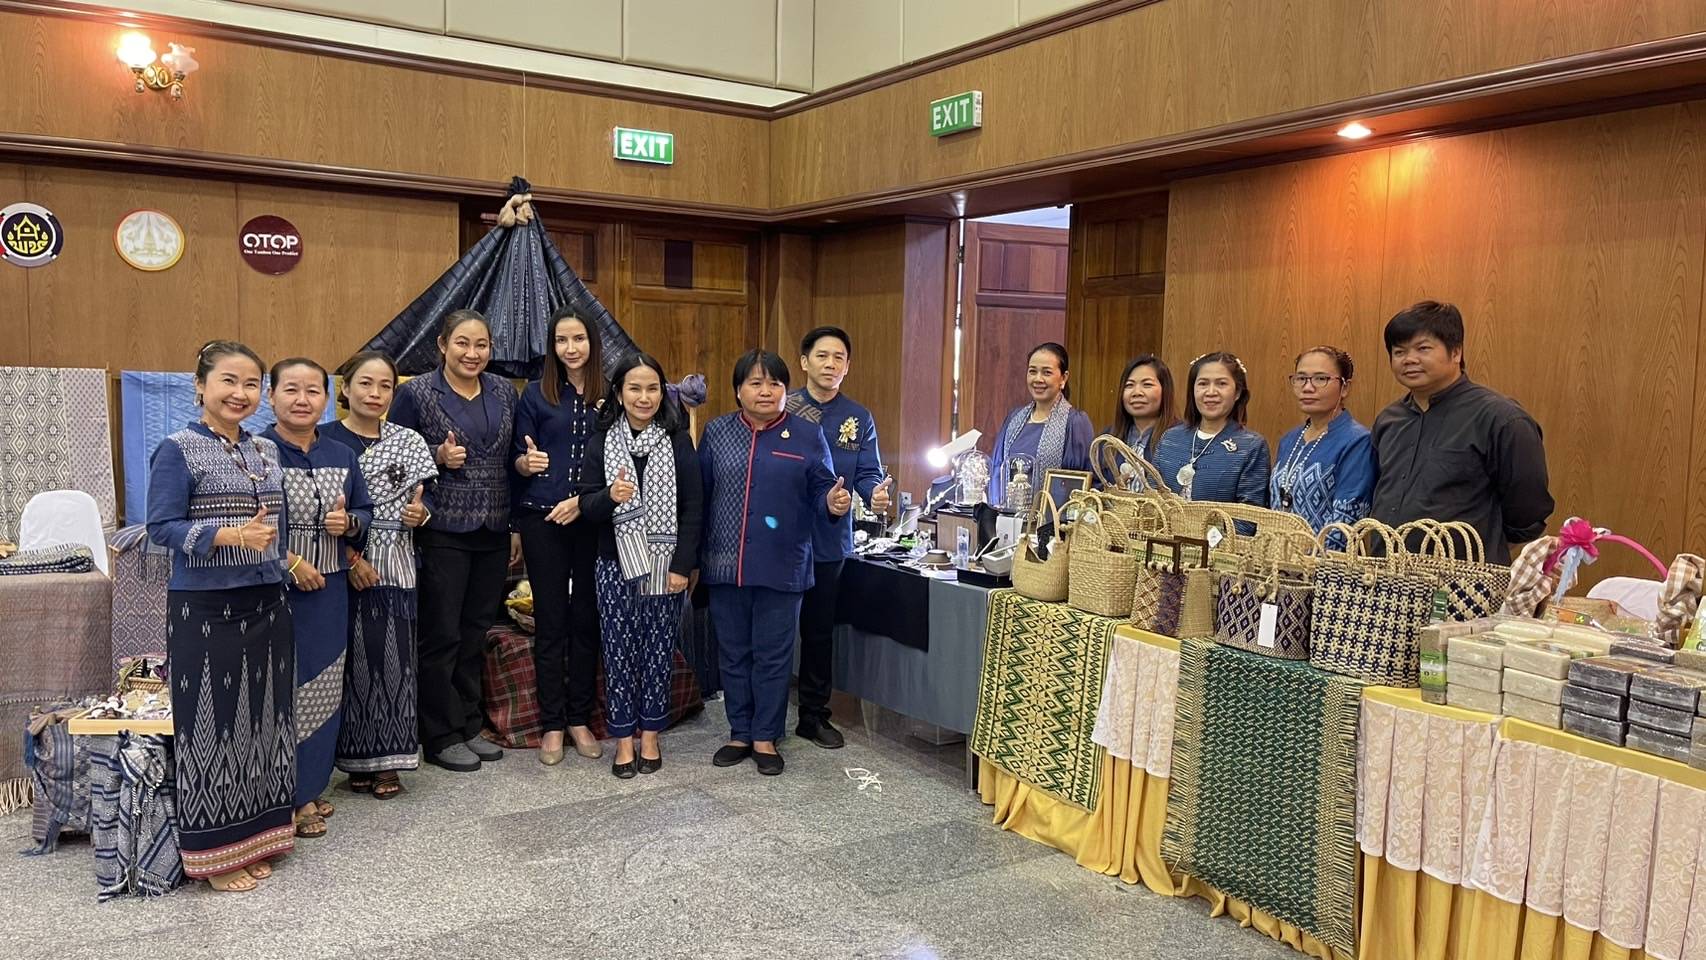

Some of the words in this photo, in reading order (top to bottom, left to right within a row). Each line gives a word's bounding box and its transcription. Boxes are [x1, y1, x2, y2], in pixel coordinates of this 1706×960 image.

[933, 98, 969, 130] EXIT
[621, 132, 669, 158] EXIT
[243, 233, 299, 249] OTOP
